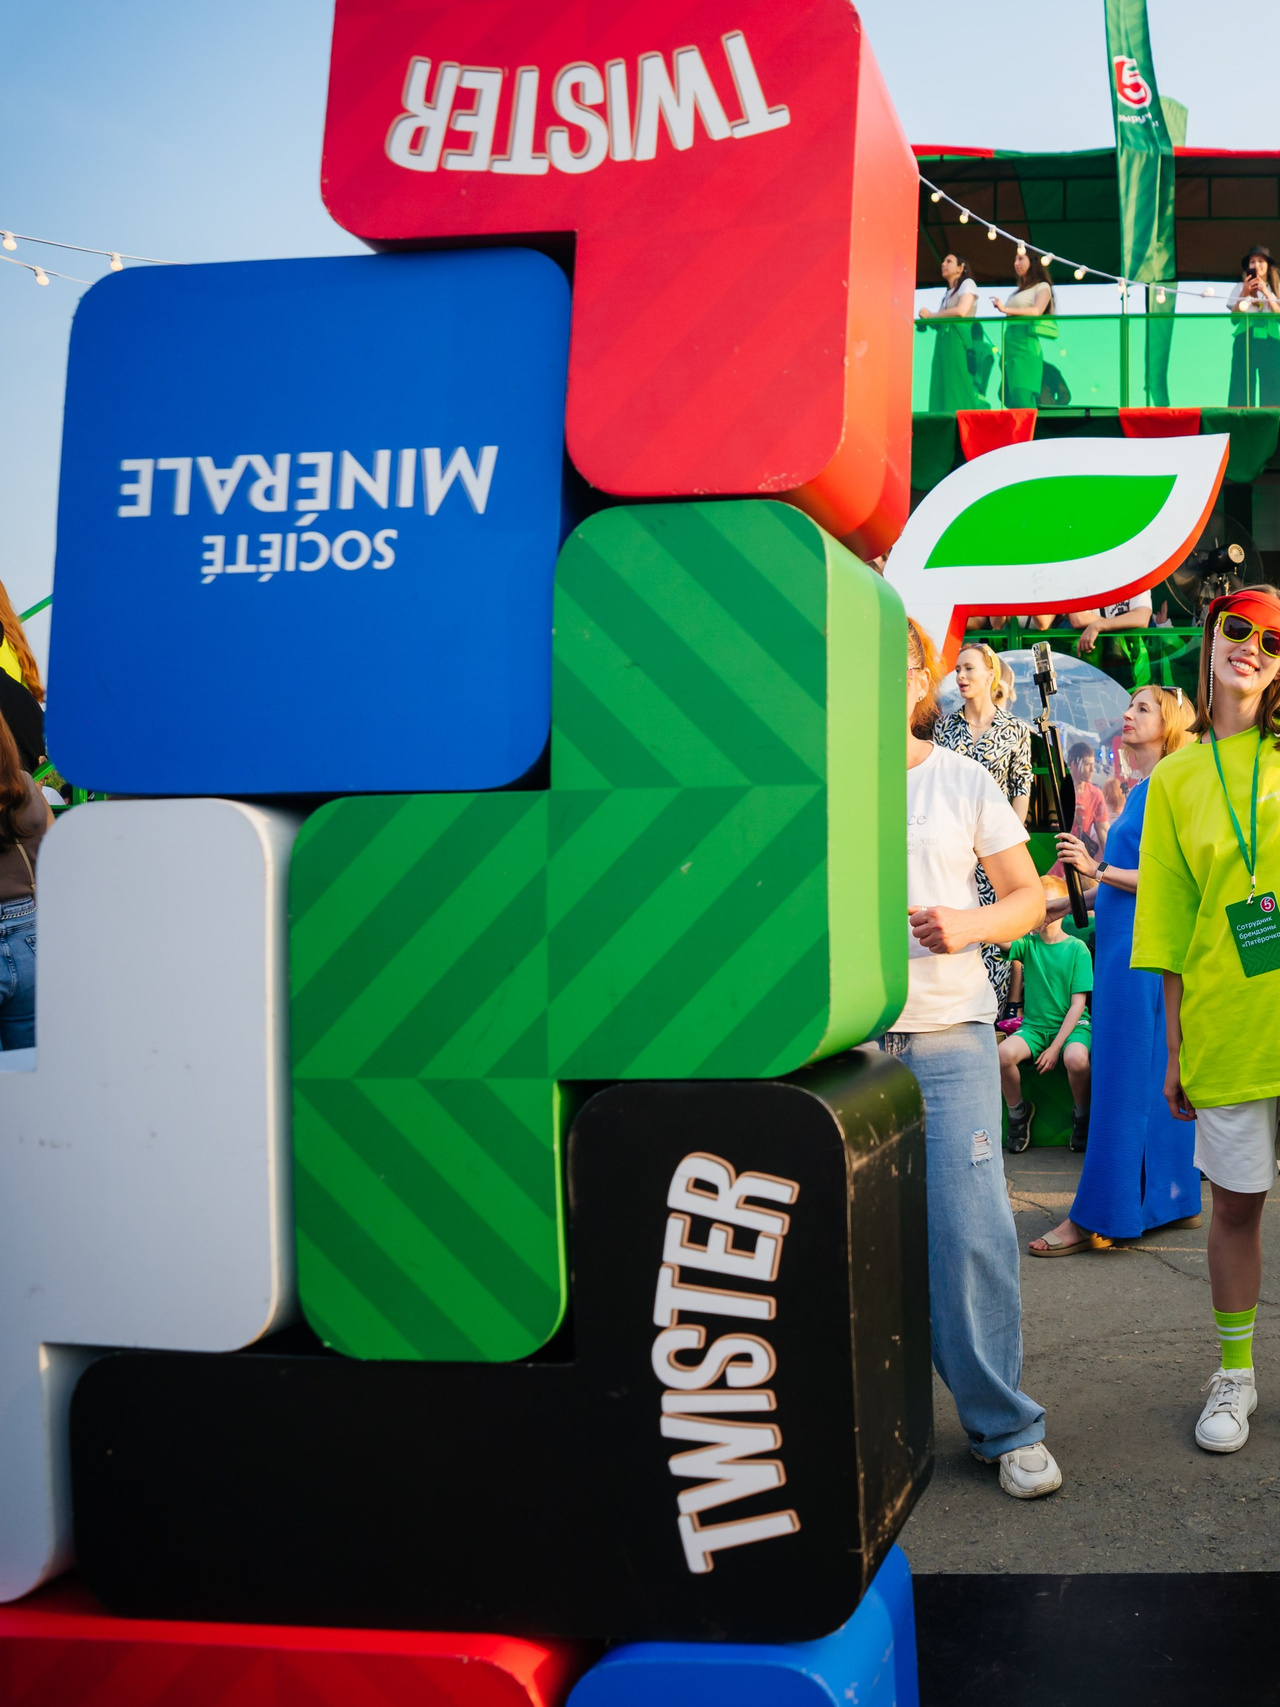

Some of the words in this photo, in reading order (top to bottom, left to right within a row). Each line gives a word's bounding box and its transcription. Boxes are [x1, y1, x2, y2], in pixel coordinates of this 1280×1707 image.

[386, 30, 791, 175] TWISTER
[201, 528, 398, 585] SOCIÉTÉ
[1236, 916, 1273, 931] Сотрудник
[1239, 924, 1277, 940] брендзоны
[652, 1153, 799, 1573] TWISTER
